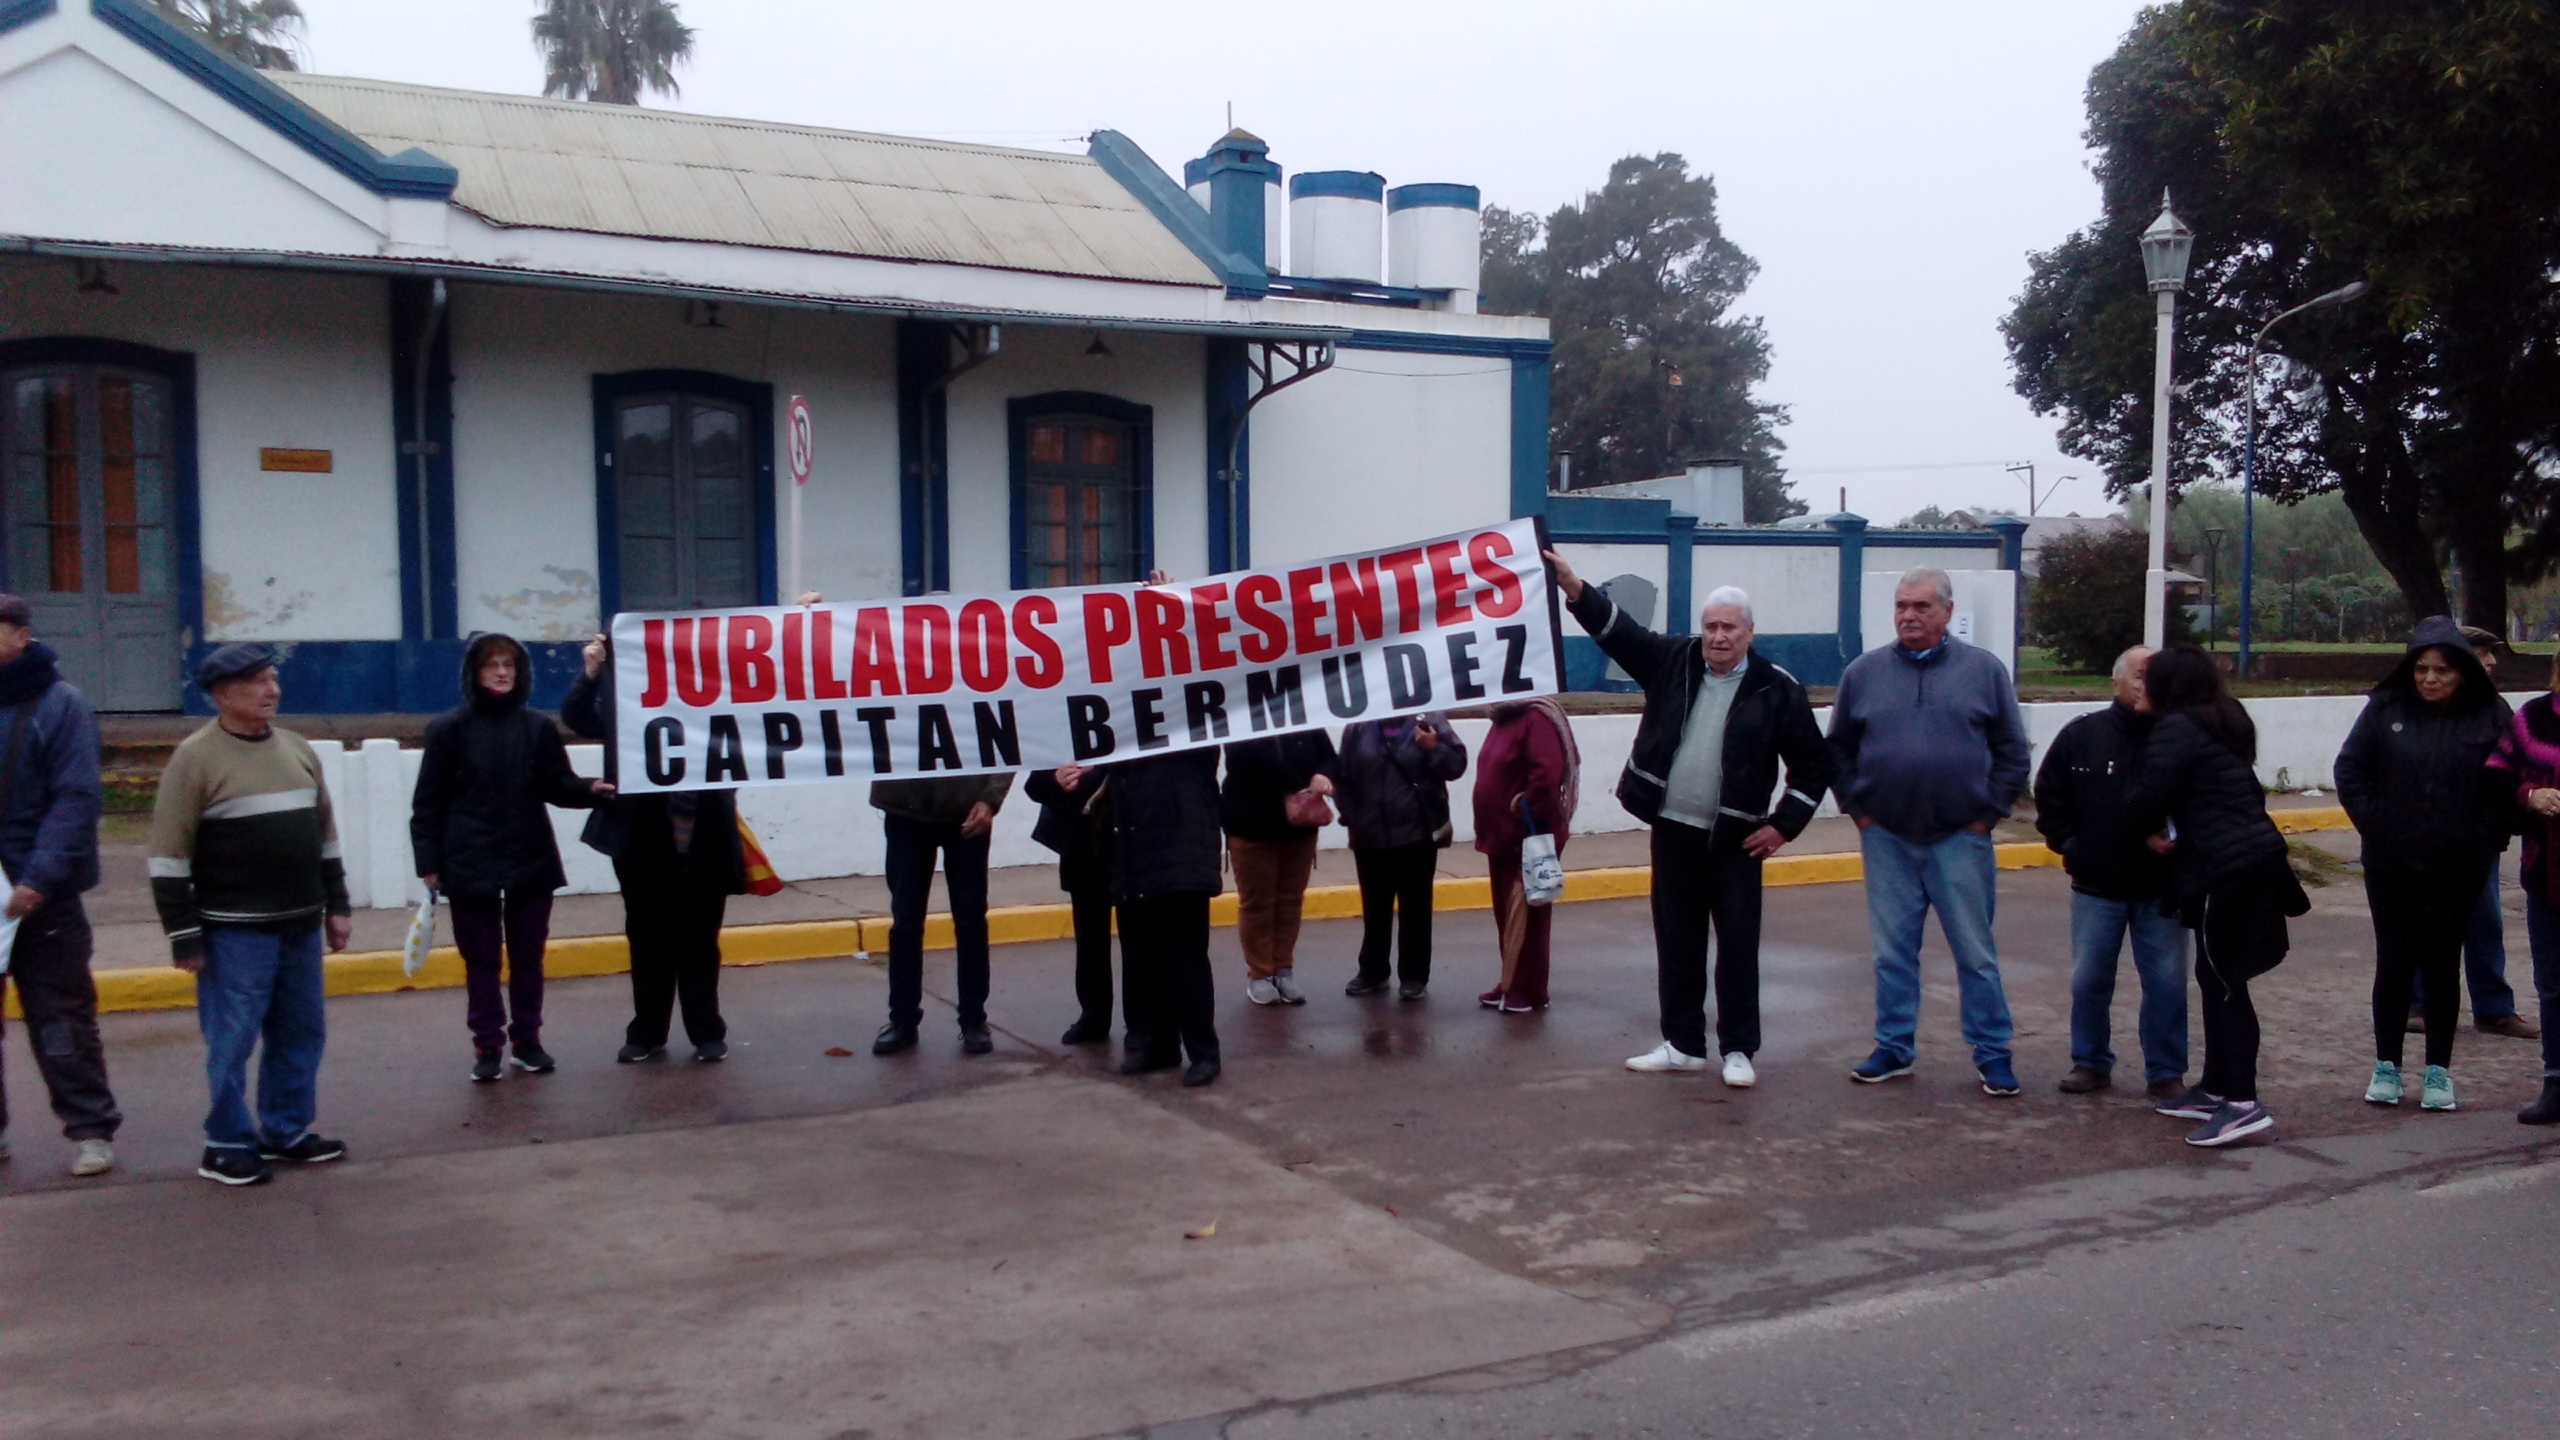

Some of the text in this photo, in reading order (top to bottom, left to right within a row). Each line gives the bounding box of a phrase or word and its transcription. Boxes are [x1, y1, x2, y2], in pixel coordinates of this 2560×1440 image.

[641, 532, 1524, 708] JUBILADOS PRESENTES
[644, 625, 1534, 786] CAPITAN BERMUDEZ
